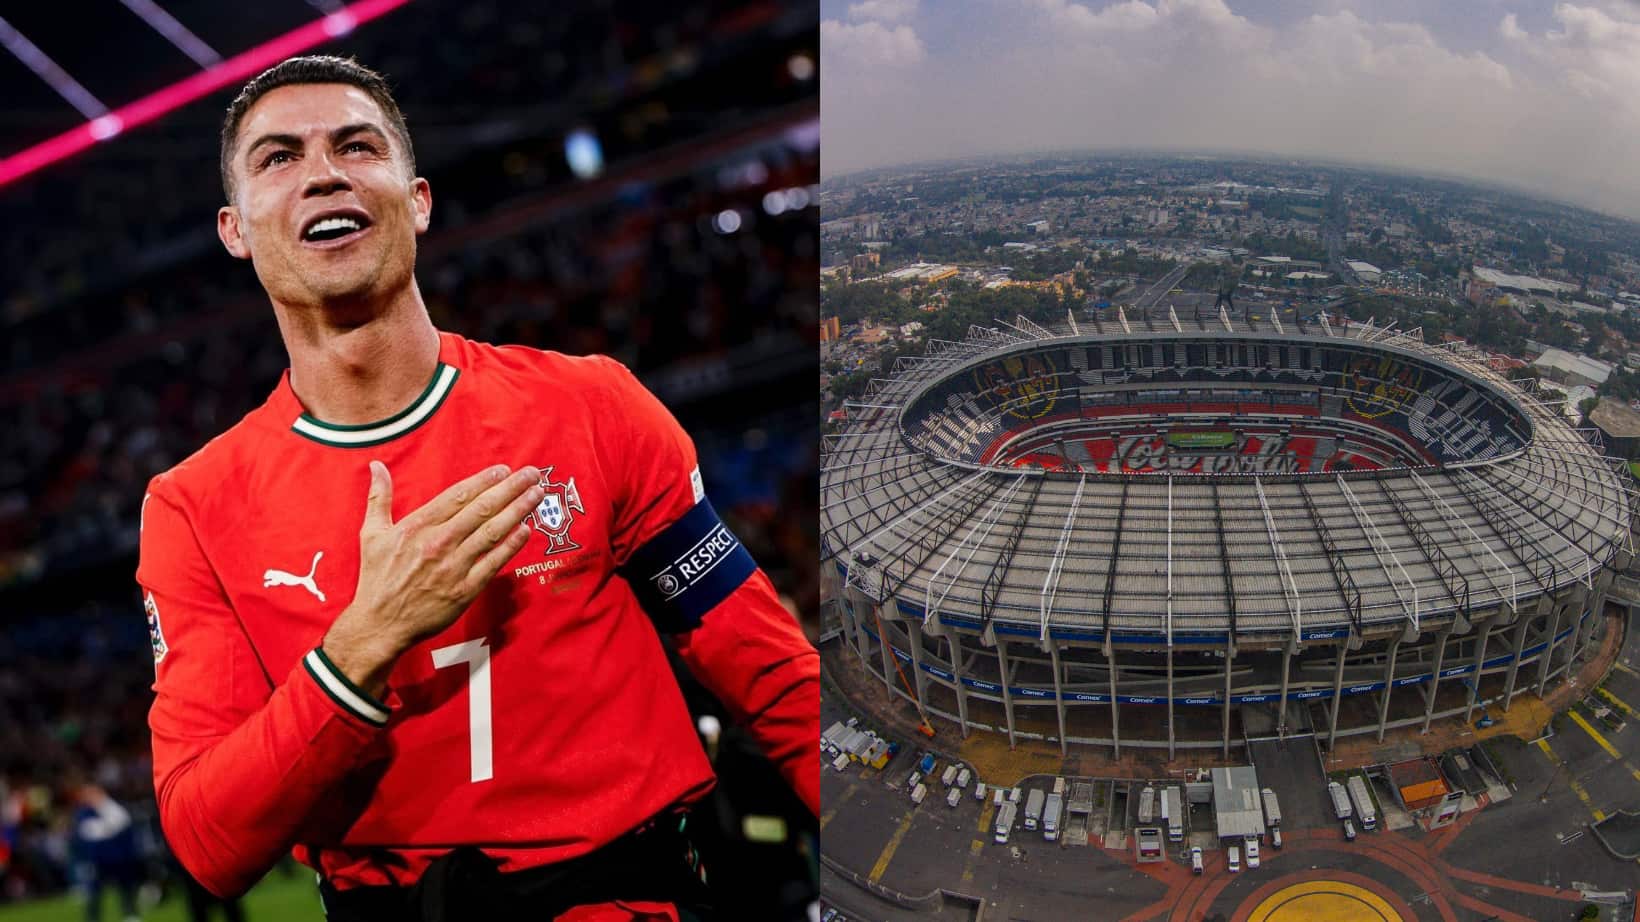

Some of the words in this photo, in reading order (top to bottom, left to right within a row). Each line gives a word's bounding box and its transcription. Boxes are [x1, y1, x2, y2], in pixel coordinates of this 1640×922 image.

[679, 528, 734, 579] RESPECT
[515, 559, 565, 578] PORTUGAL
[973, 681, 994, 690] Comex
[1351, 684, 1374, 693] Comex
[1022, 689, 1045, 697] Comex
[1298, 691, 1323, 699] Comex
[431, 637, 493, 783] 7
